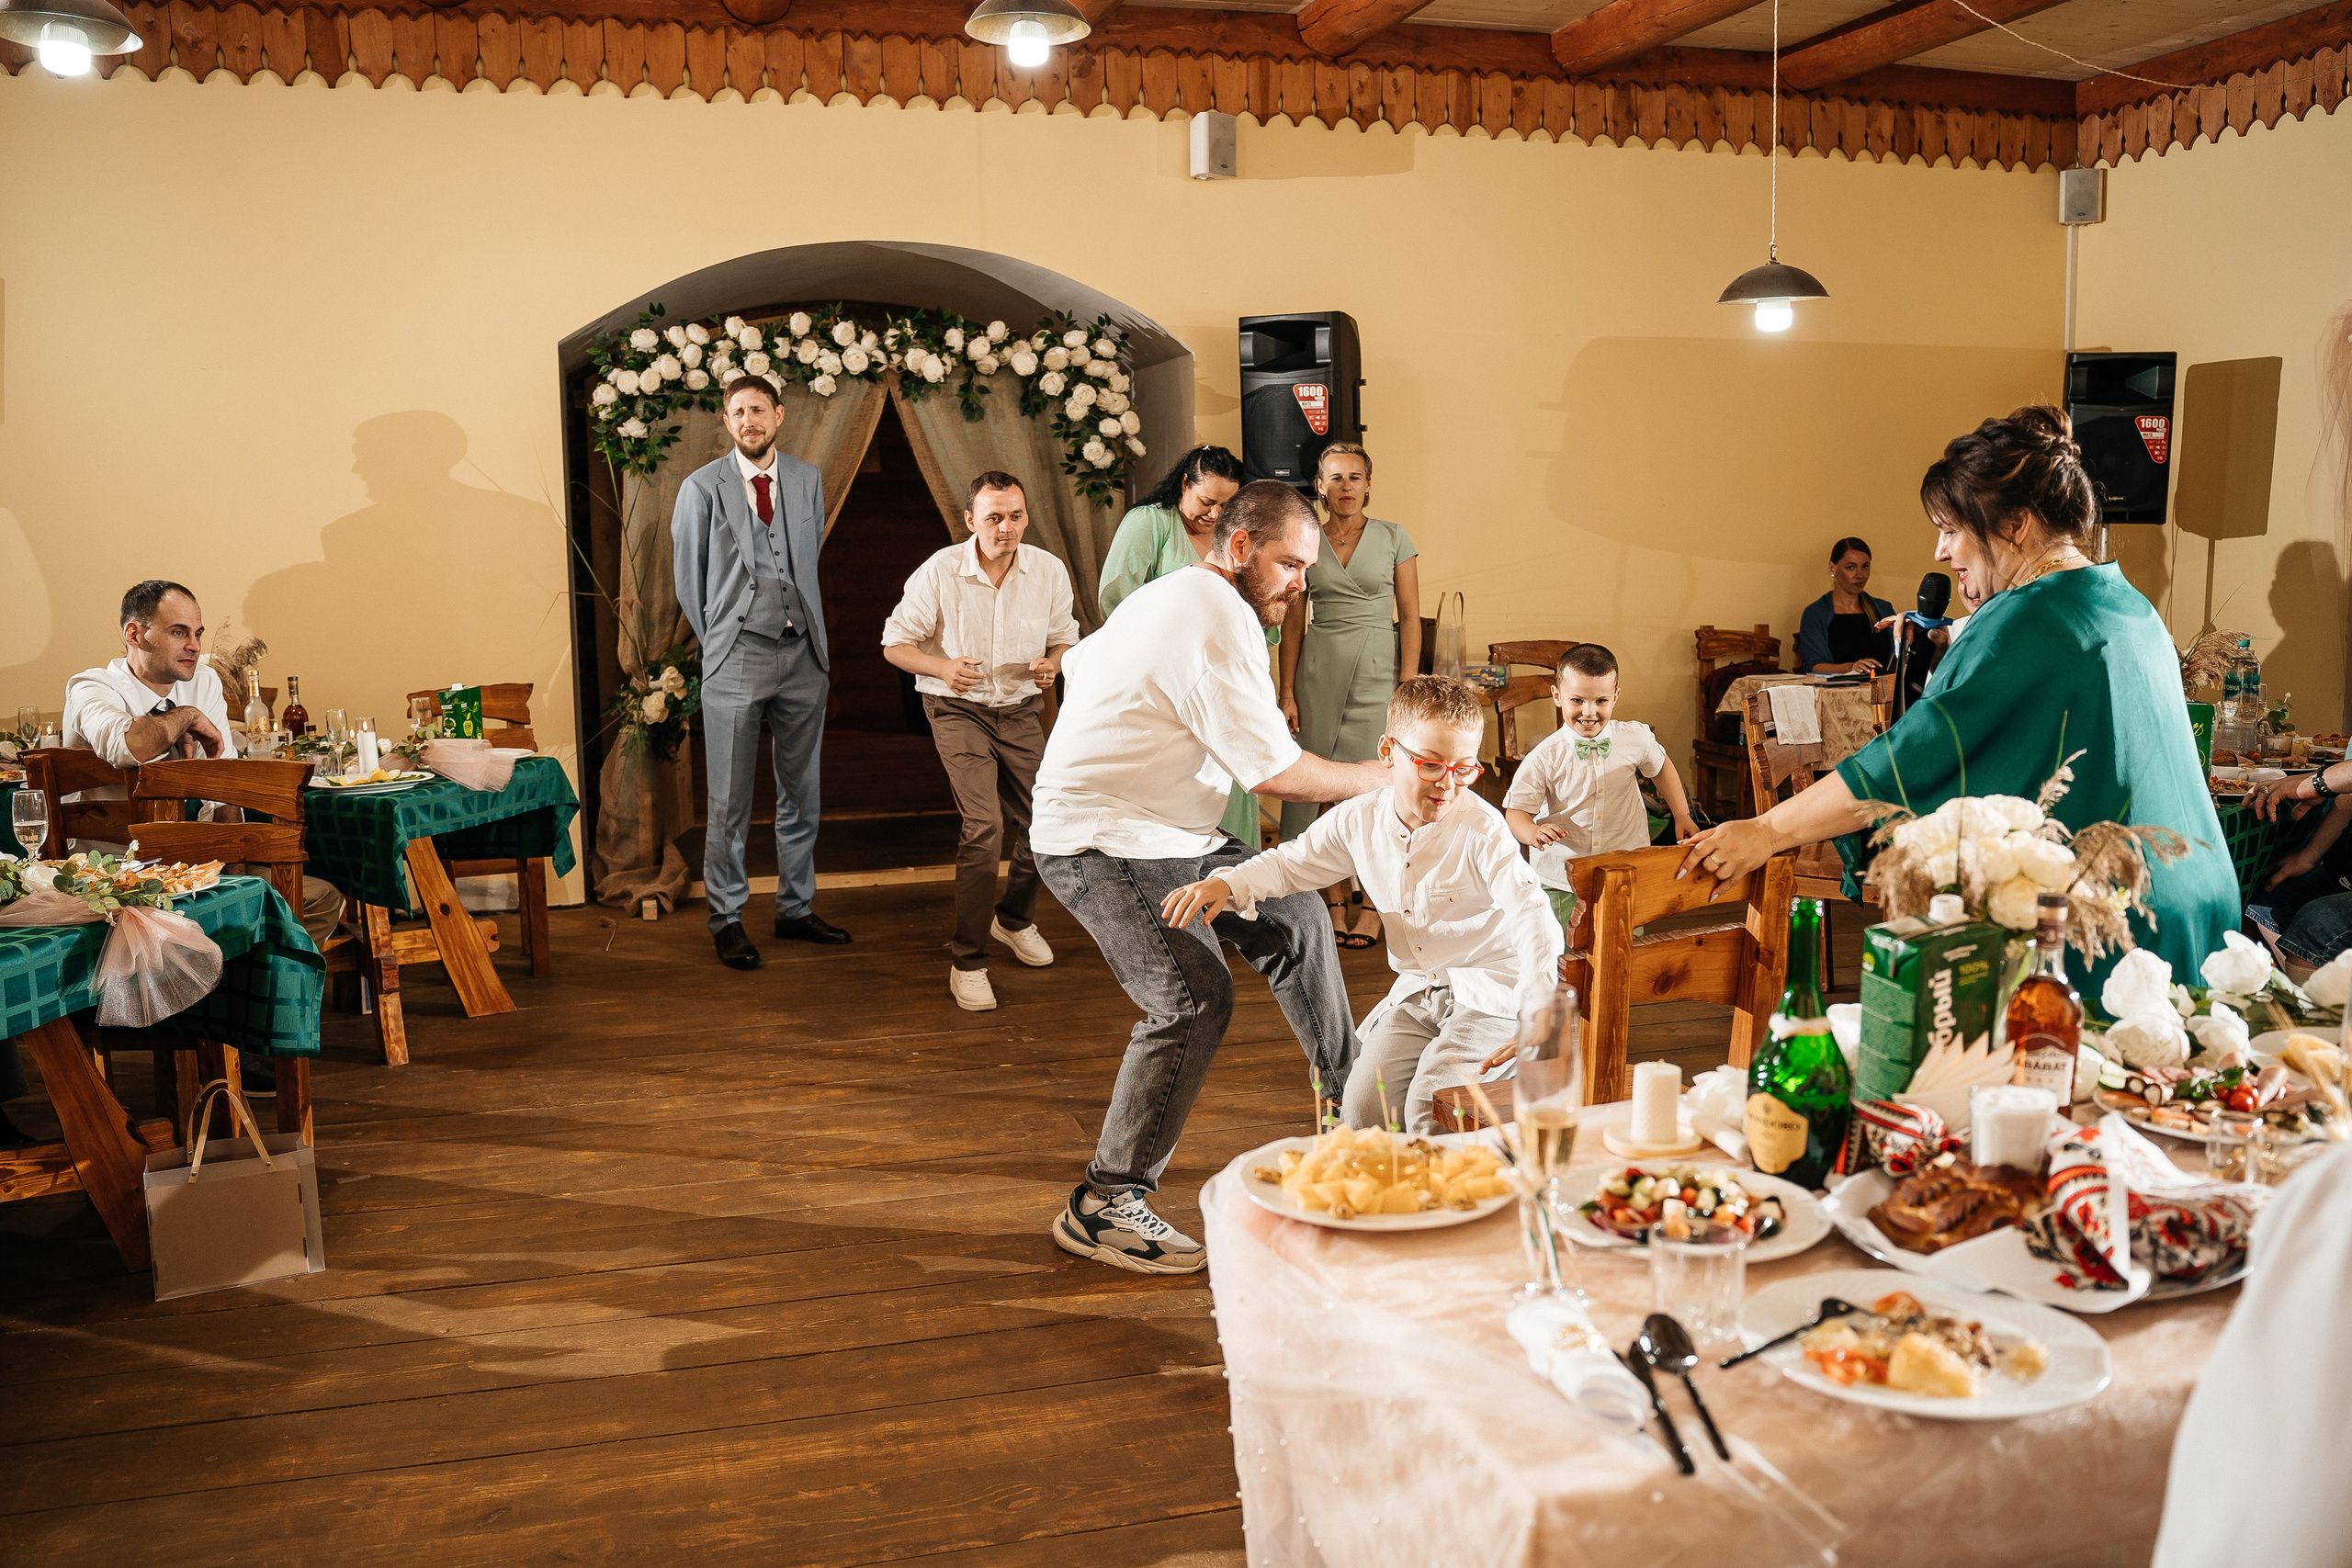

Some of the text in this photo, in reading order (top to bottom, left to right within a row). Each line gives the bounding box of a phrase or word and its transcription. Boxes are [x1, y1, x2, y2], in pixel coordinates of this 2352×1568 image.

[1297, 386, 1323, 397] 1600
[2141, 418, 2165, 428] 1600
[1928, 968, 1957, 1046] брый
